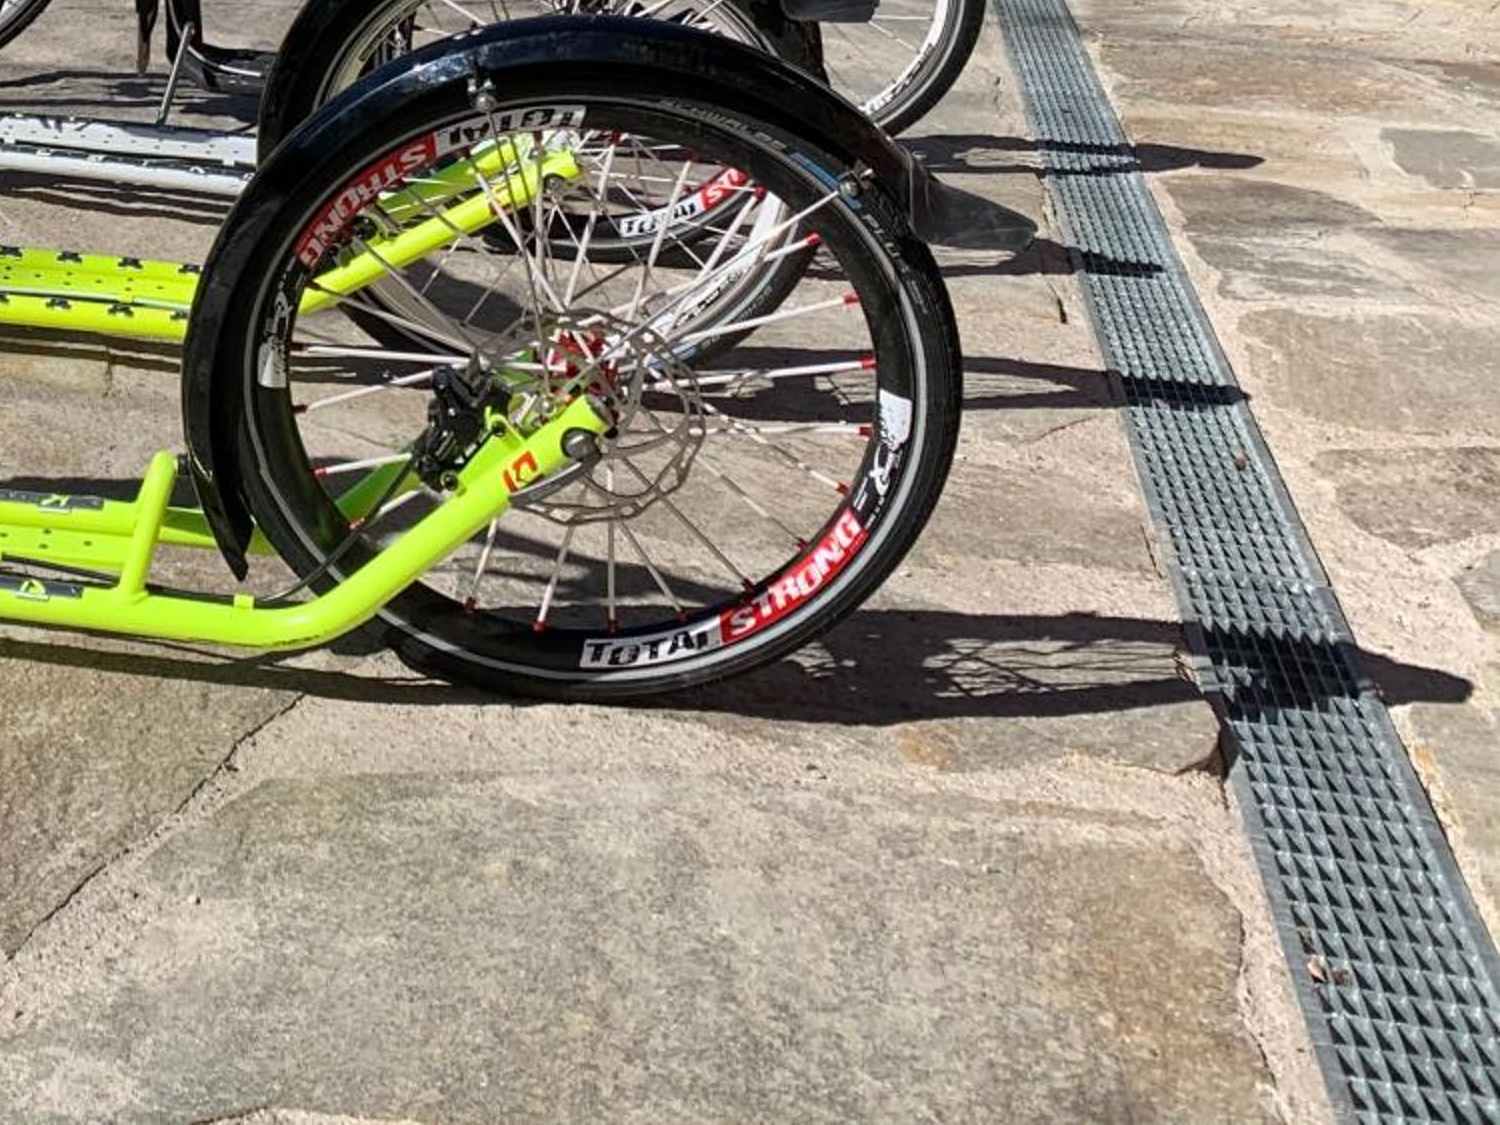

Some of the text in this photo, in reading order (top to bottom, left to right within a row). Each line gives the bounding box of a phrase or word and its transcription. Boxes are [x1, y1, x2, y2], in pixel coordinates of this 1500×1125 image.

[298, 143, 428, 268] STRONG
[584, 627, 716, 667] TOTAL
[729, 509, 863, 638] STRONG
